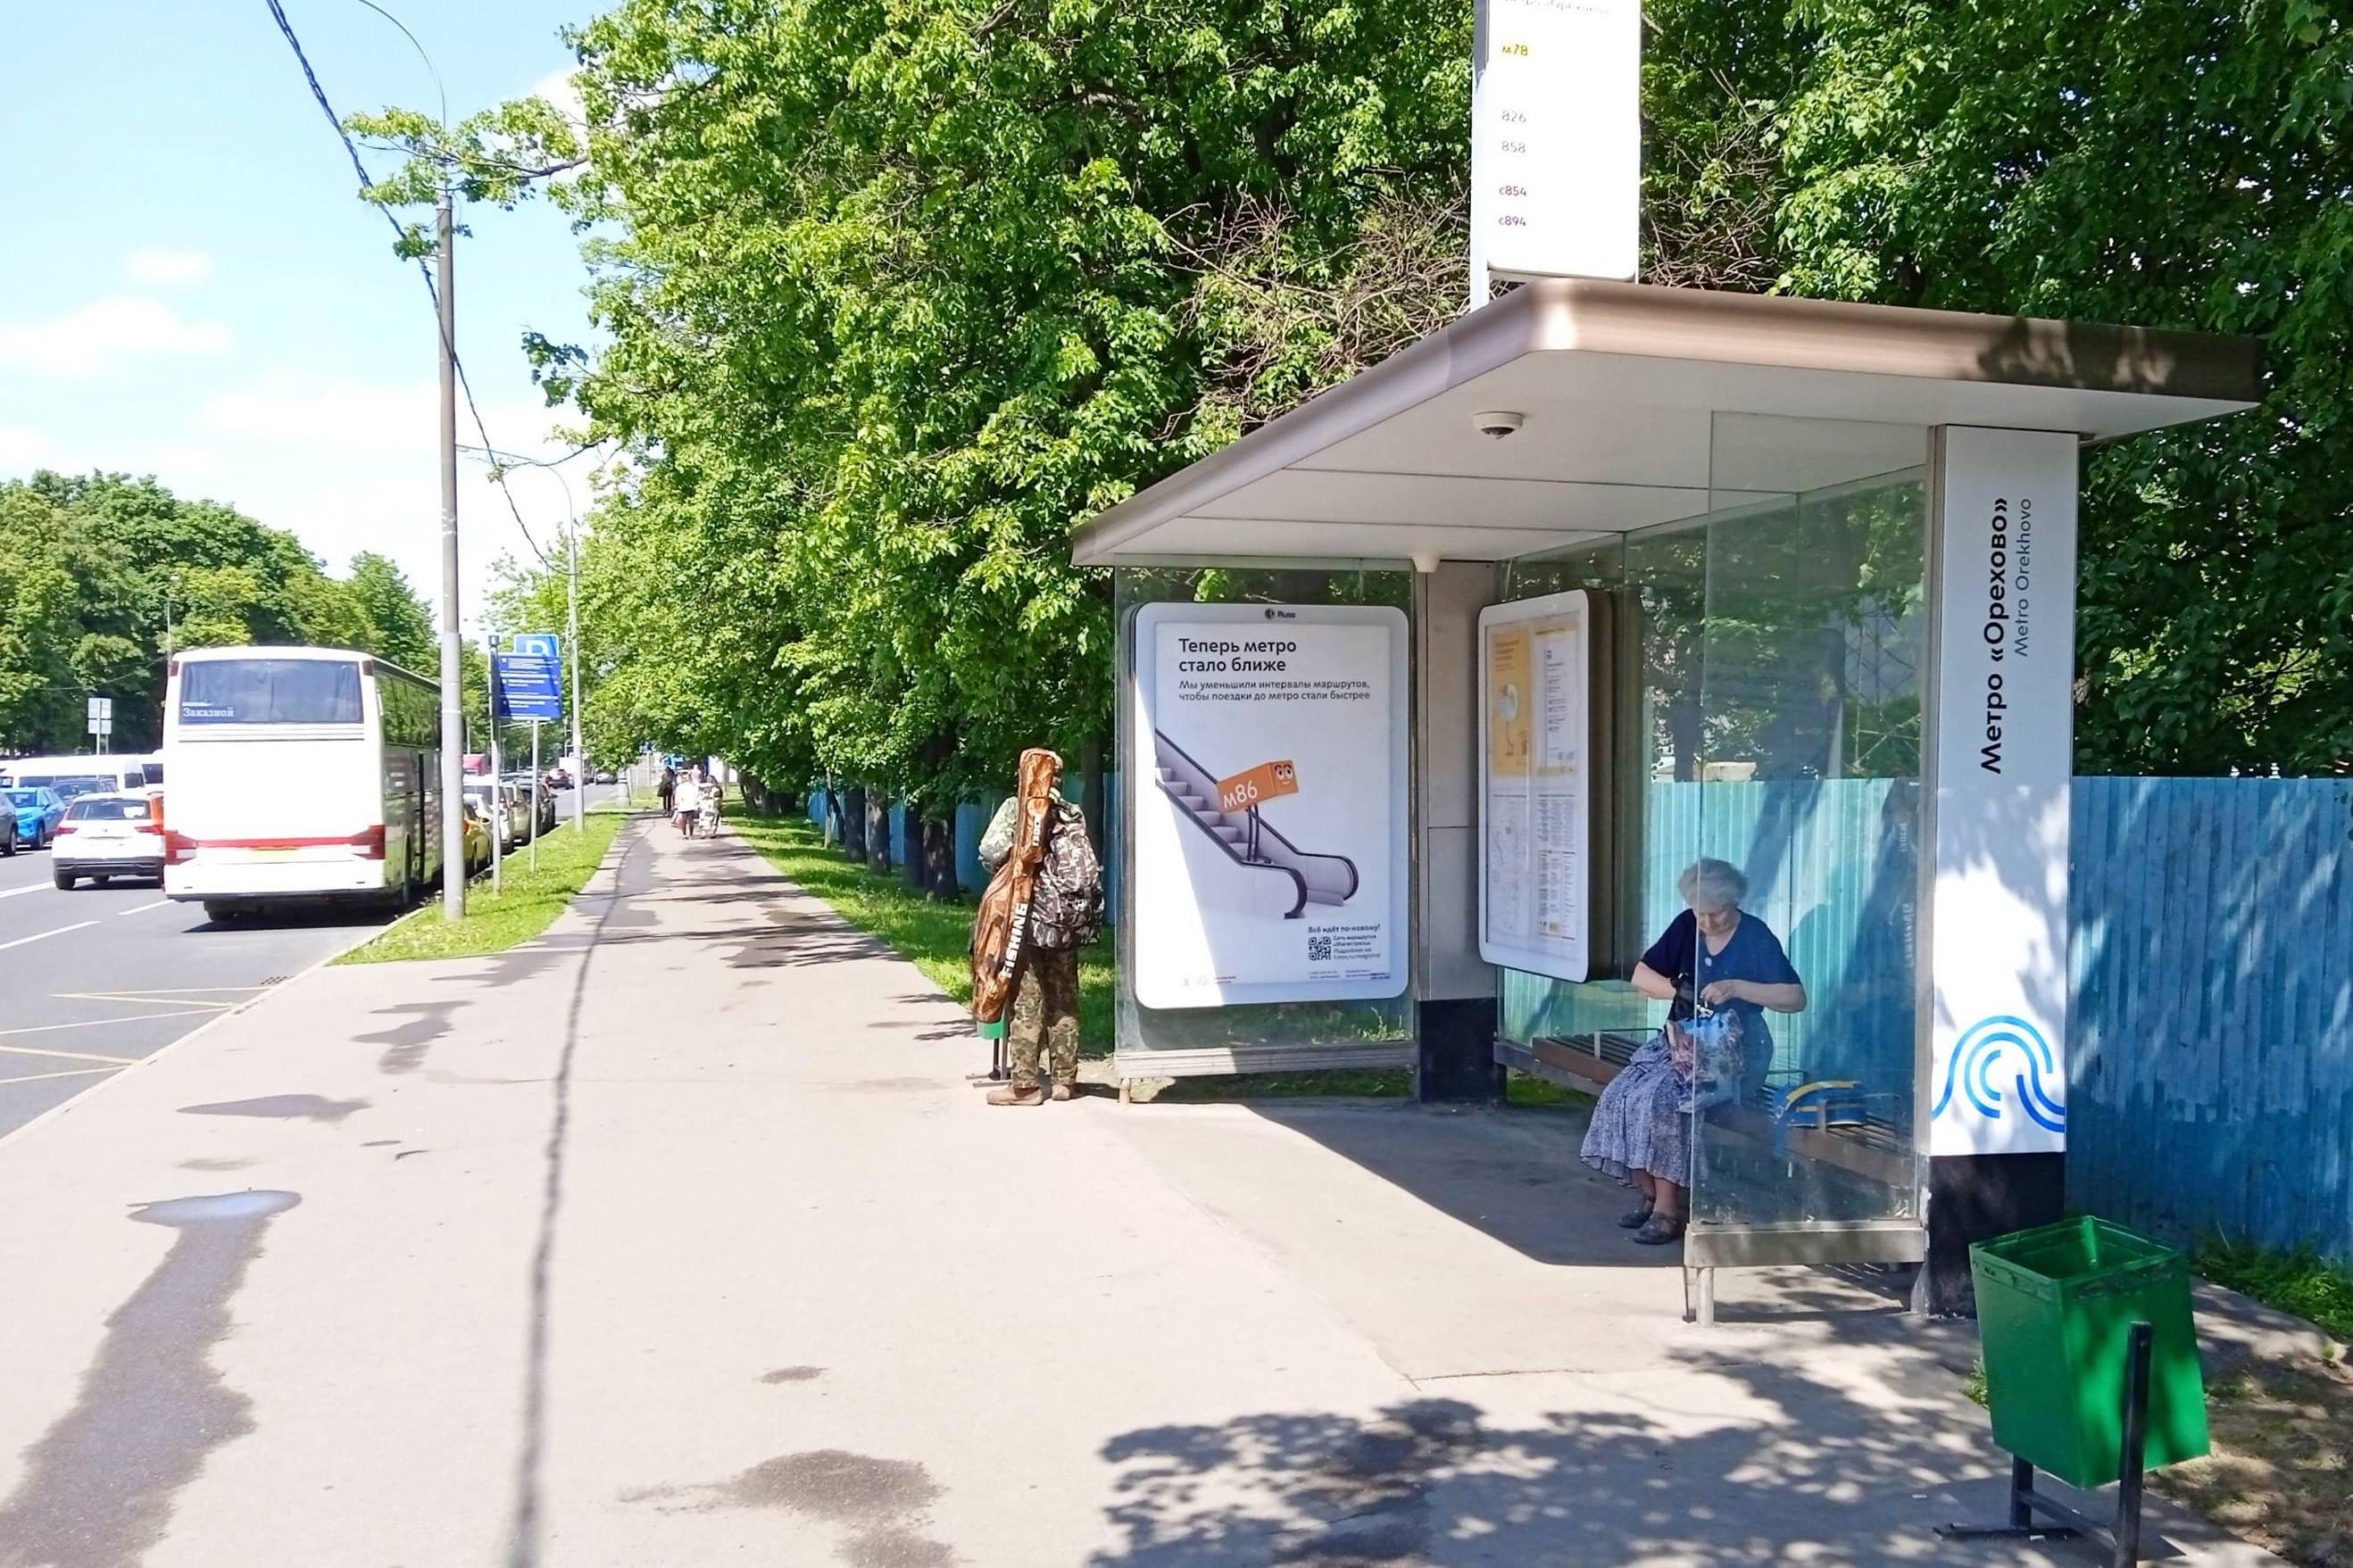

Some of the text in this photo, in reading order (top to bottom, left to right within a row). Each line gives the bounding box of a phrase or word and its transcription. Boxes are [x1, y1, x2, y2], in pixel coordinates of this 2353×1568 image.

[1501, 110, 1527, 123] 826
[1501, 141, 1526, 153] 858
[2014, 498, 2032, 657] Metro Orekhovo
[1980, 497, 2009, 775] Метро «Орехово»
[1178, 638, 1297, 656] Теперь метро
[1179, 657, 1286, 672] стало ближе
[1179, 680, 1370, 691] Мы уменьшили интервалы маршрутов,
[1179, 691, 1370, 701] чтобы поездки до метро стали быстрее
[1000, 902, 1029, 979] FISHING
